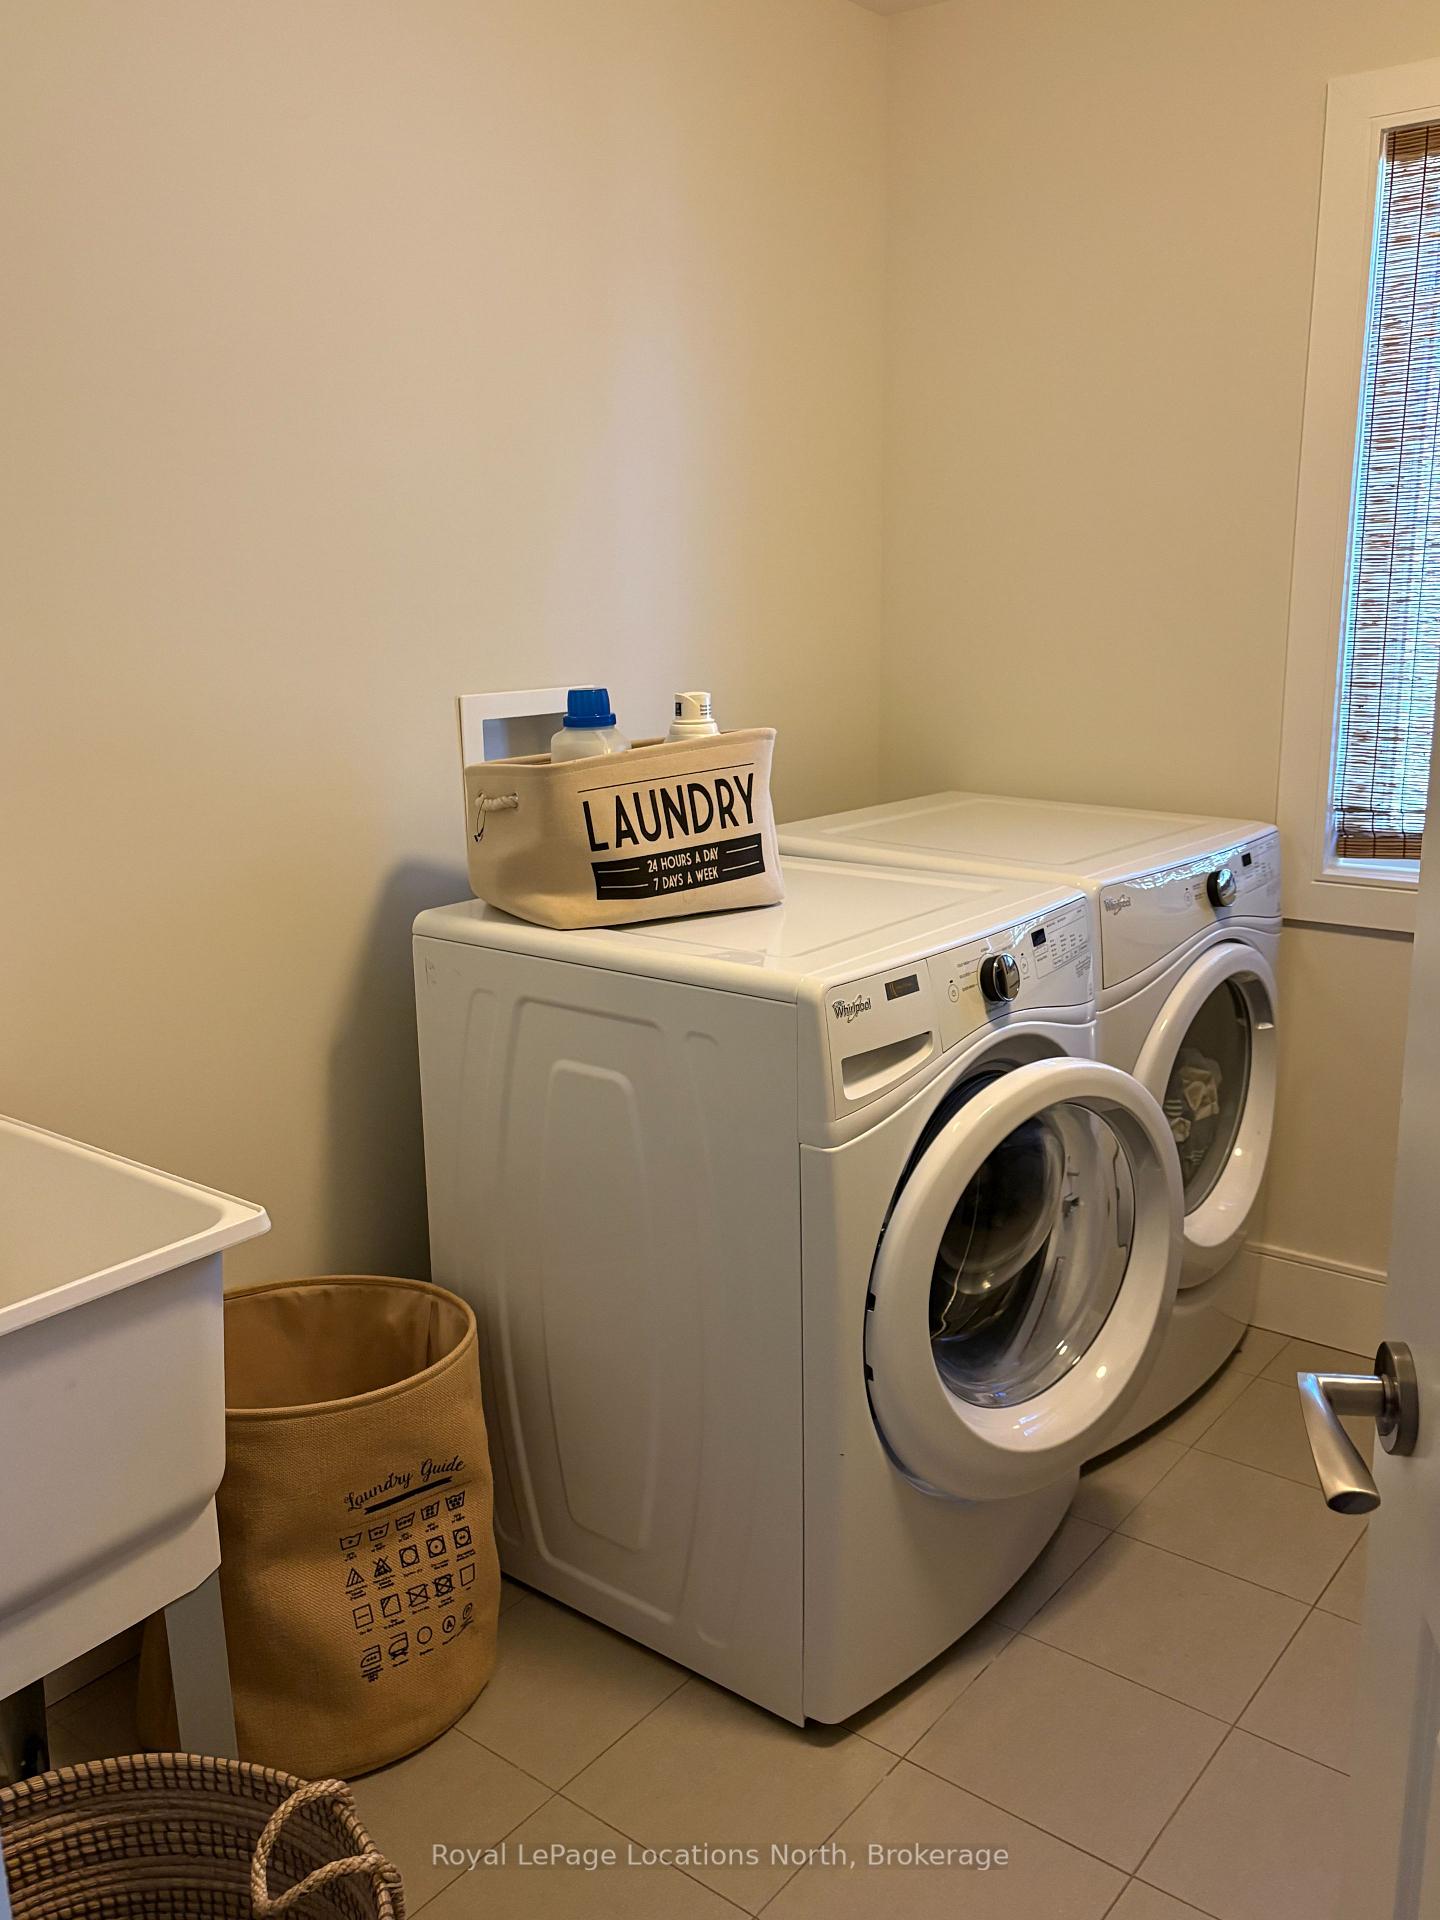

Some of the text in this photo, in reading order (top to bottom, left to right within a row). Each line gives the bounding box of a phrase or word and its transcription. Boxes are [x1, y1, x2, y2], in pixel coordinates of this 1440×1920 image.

[583, 773, 754, 852] LAUNDRY
[647, 847, 719, 873] 24 HOURS A DAY
[653, 866, 719, 891] 7 DAYS A WEEK
[832, 995, 872, 1023] Whirlpool
[344, 1455, 466, 1512] Laundry Guide
